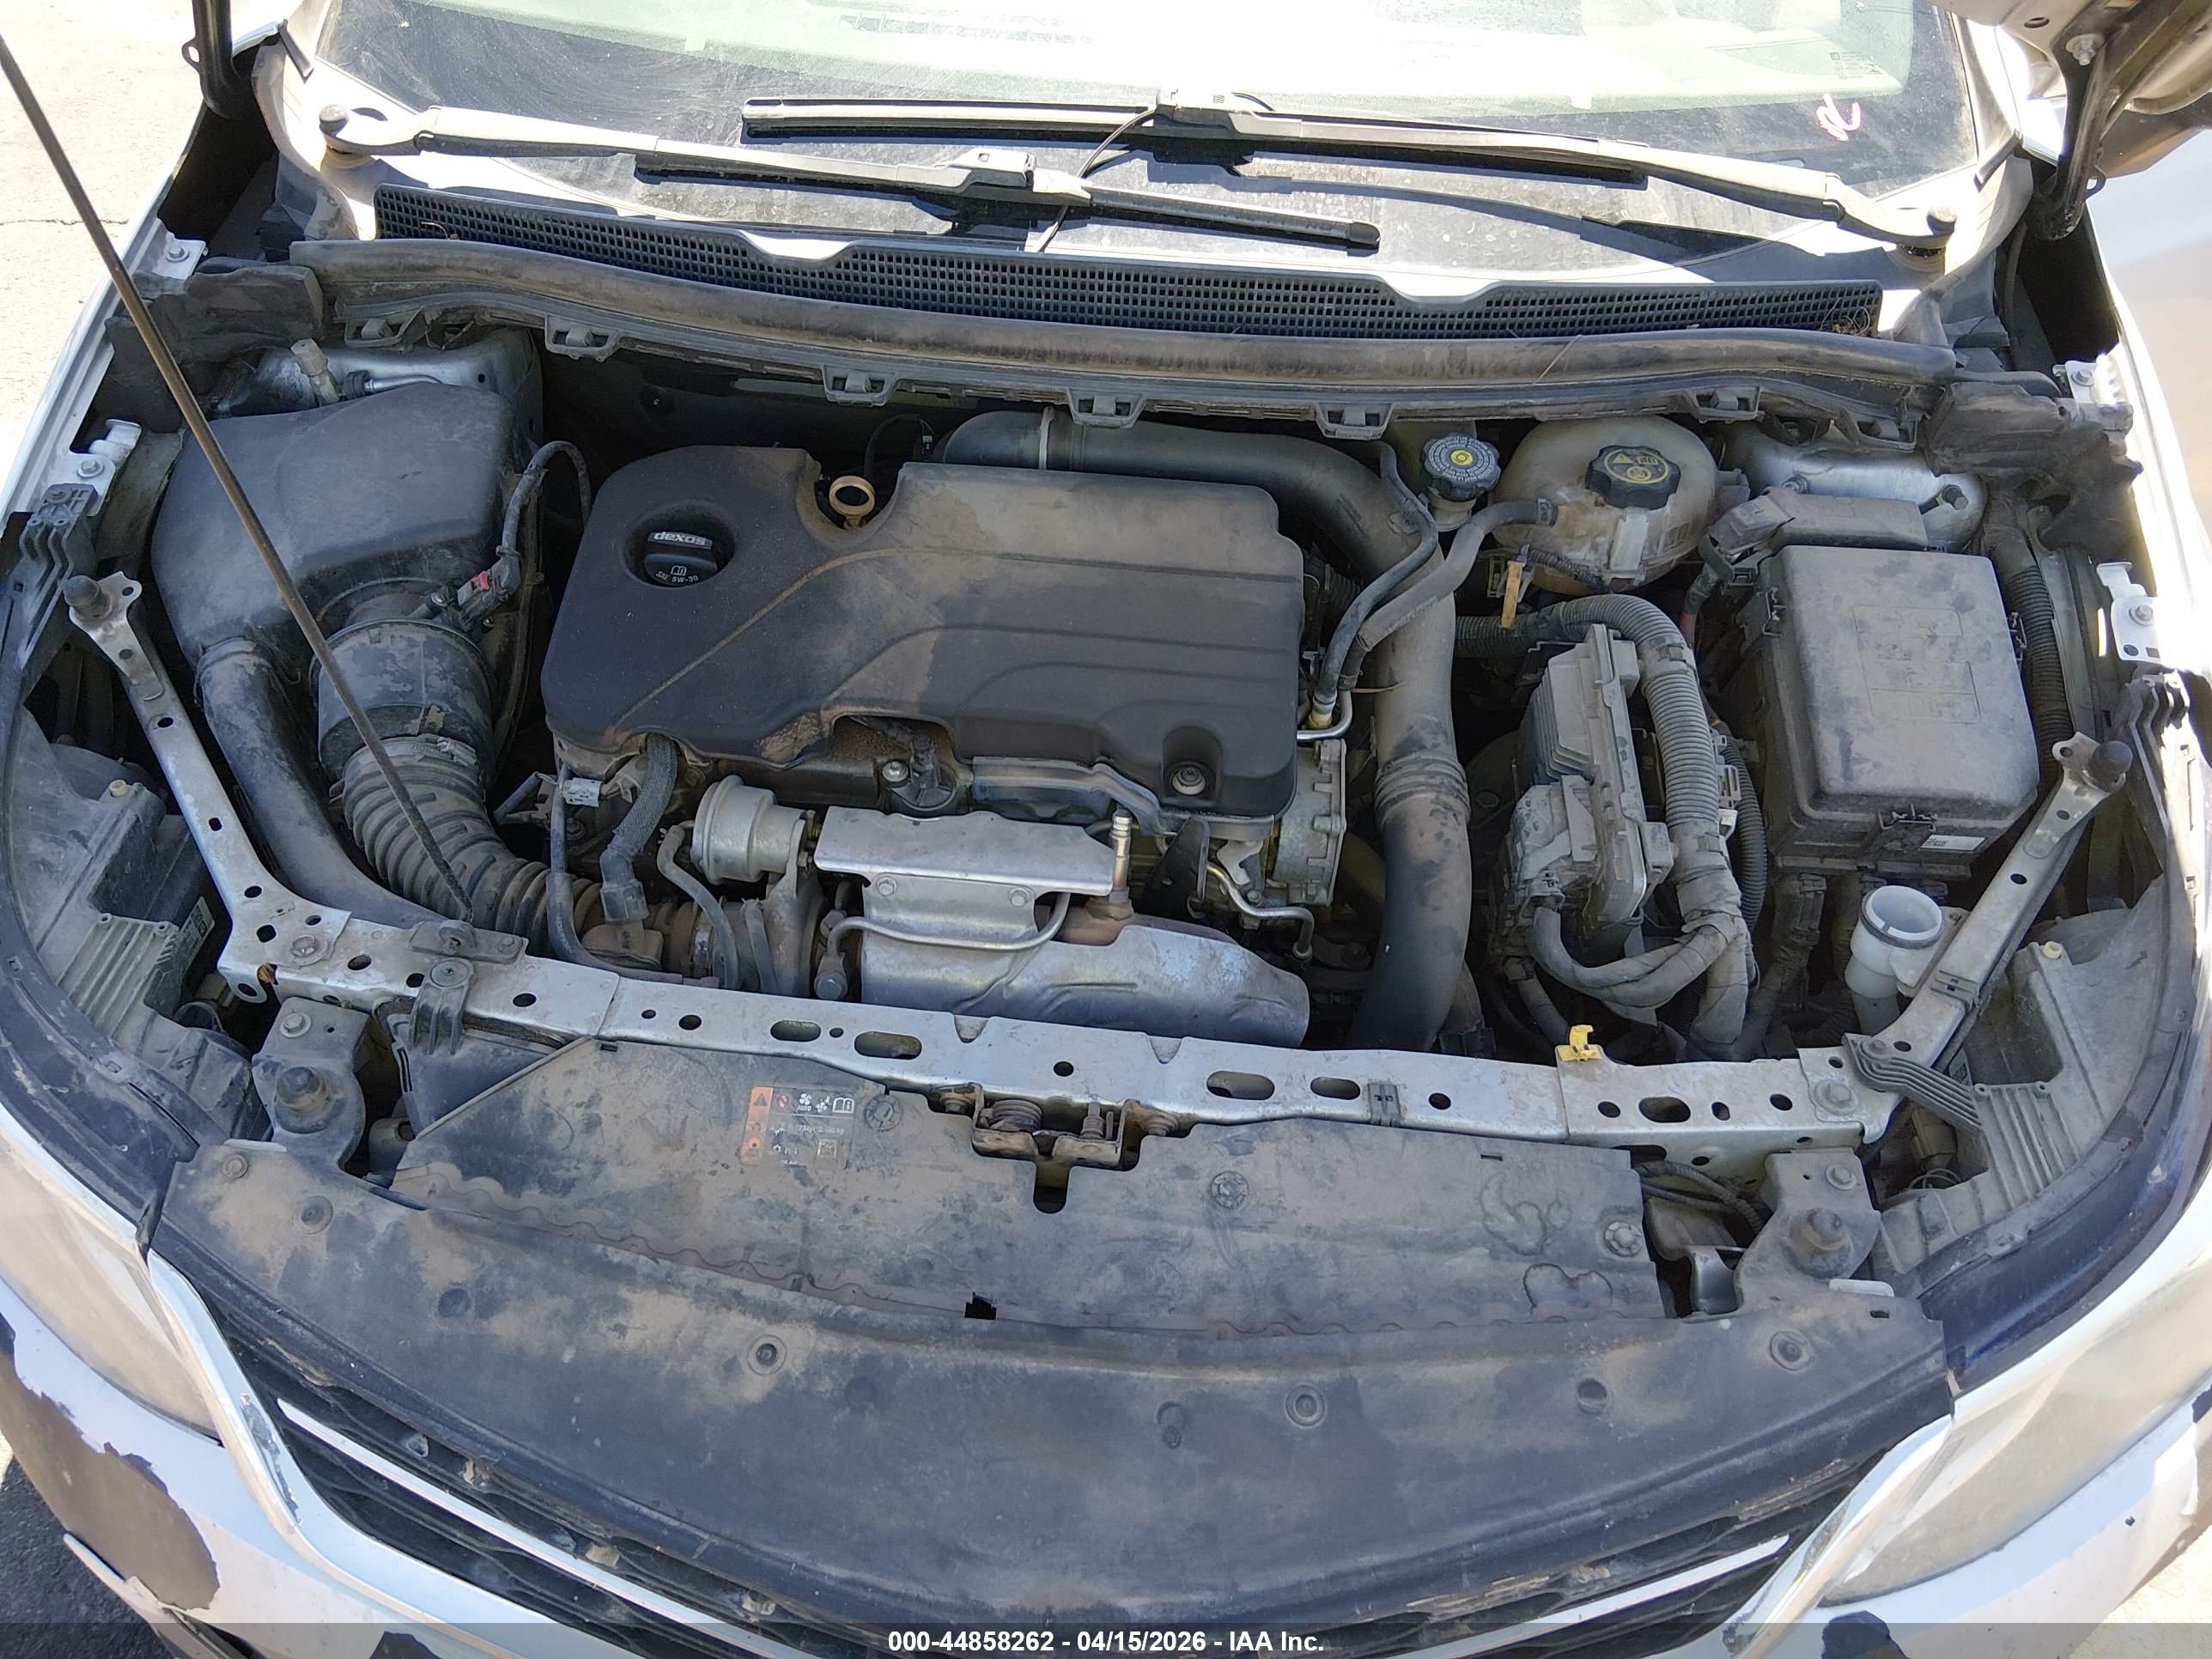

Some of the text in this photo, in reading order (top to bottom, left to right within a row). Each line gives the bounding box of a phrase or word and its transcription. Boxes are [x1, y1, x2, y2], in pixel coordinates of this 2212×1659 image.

[653, 531, 706, 545] dexos
[655, 571, 699, 583] SAE 5W-30
